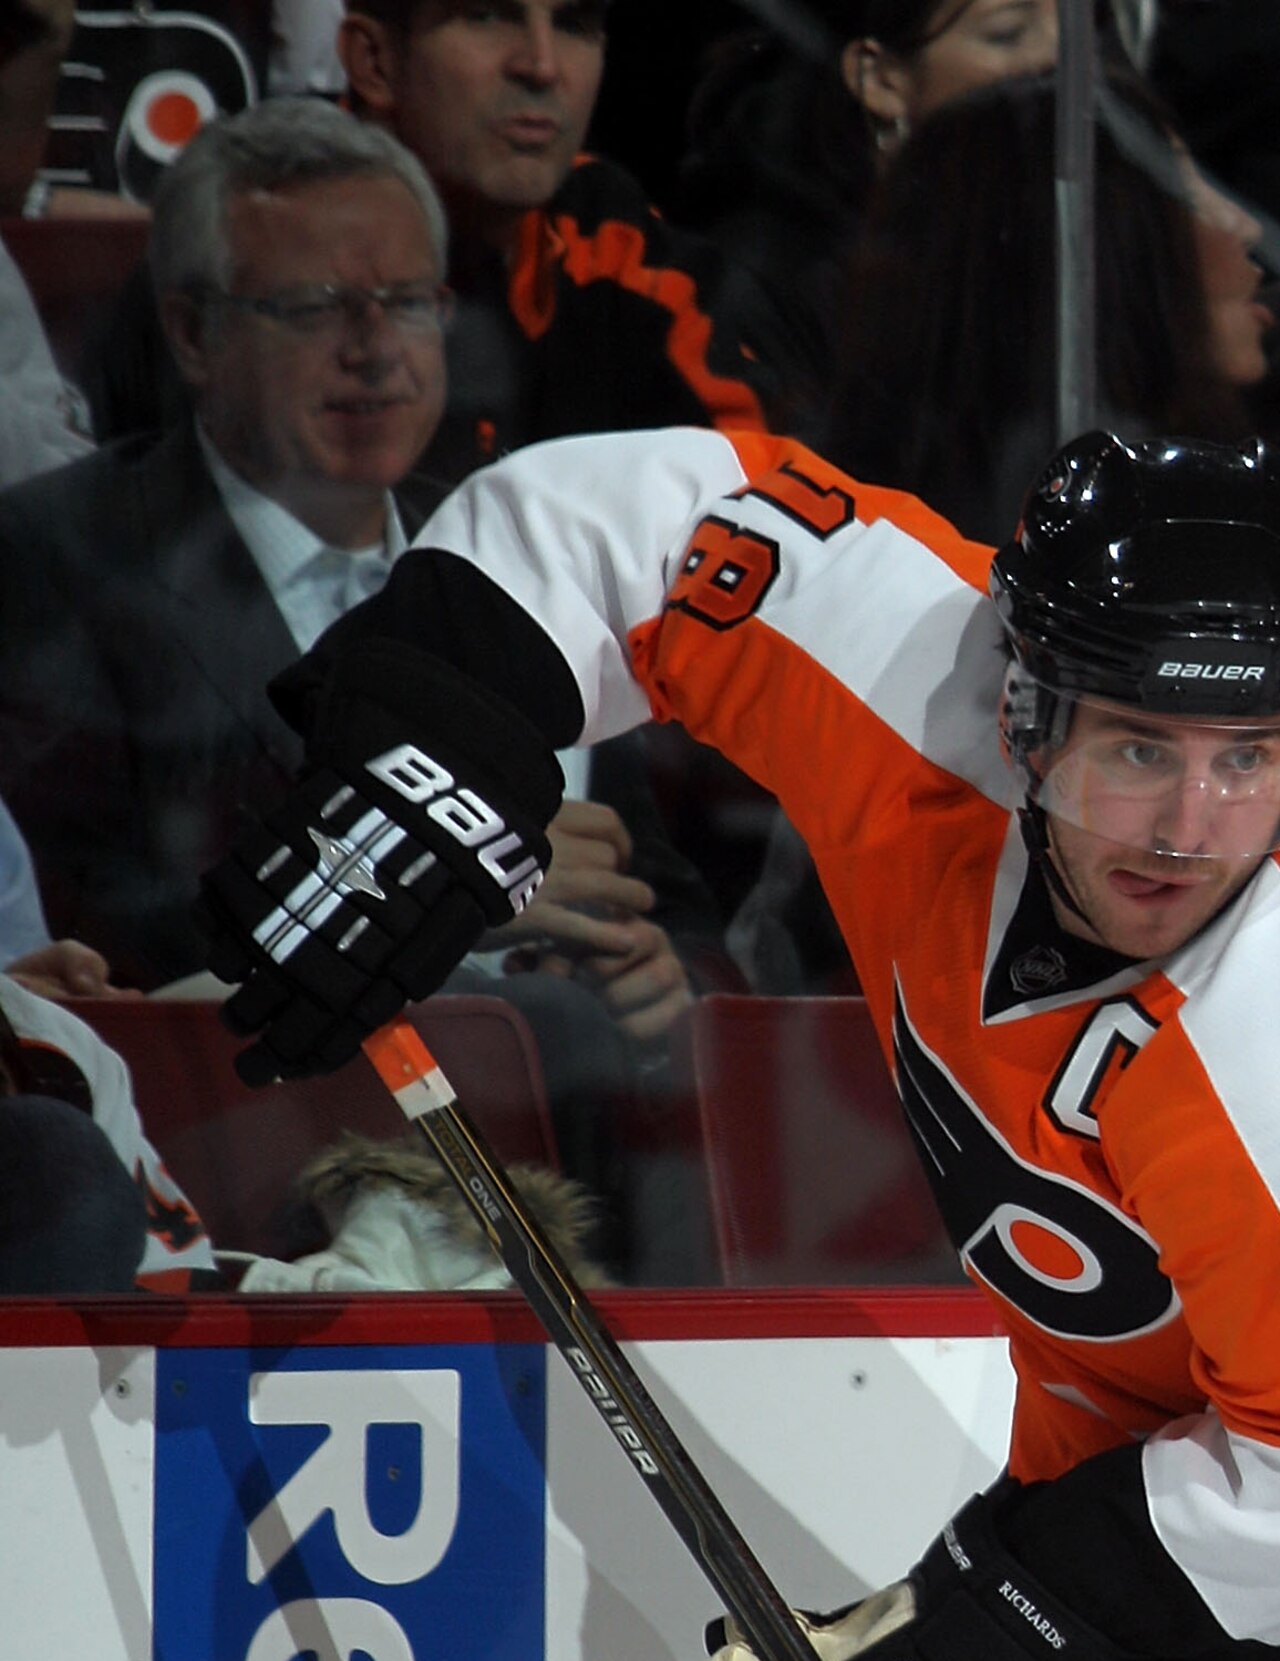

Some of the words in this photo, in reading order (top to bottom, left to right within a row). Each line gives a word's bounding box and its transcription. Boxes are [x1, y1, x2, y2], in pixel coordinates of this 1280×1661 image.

[665, 460, 854, 632] 18
[1158, 662, 1265, 680] BAUER
[364, 743, 543, 915] BAUE
[1041, 994, 1162, 1142] C
[999, 1580, 1066, 1649] RICHARDS
